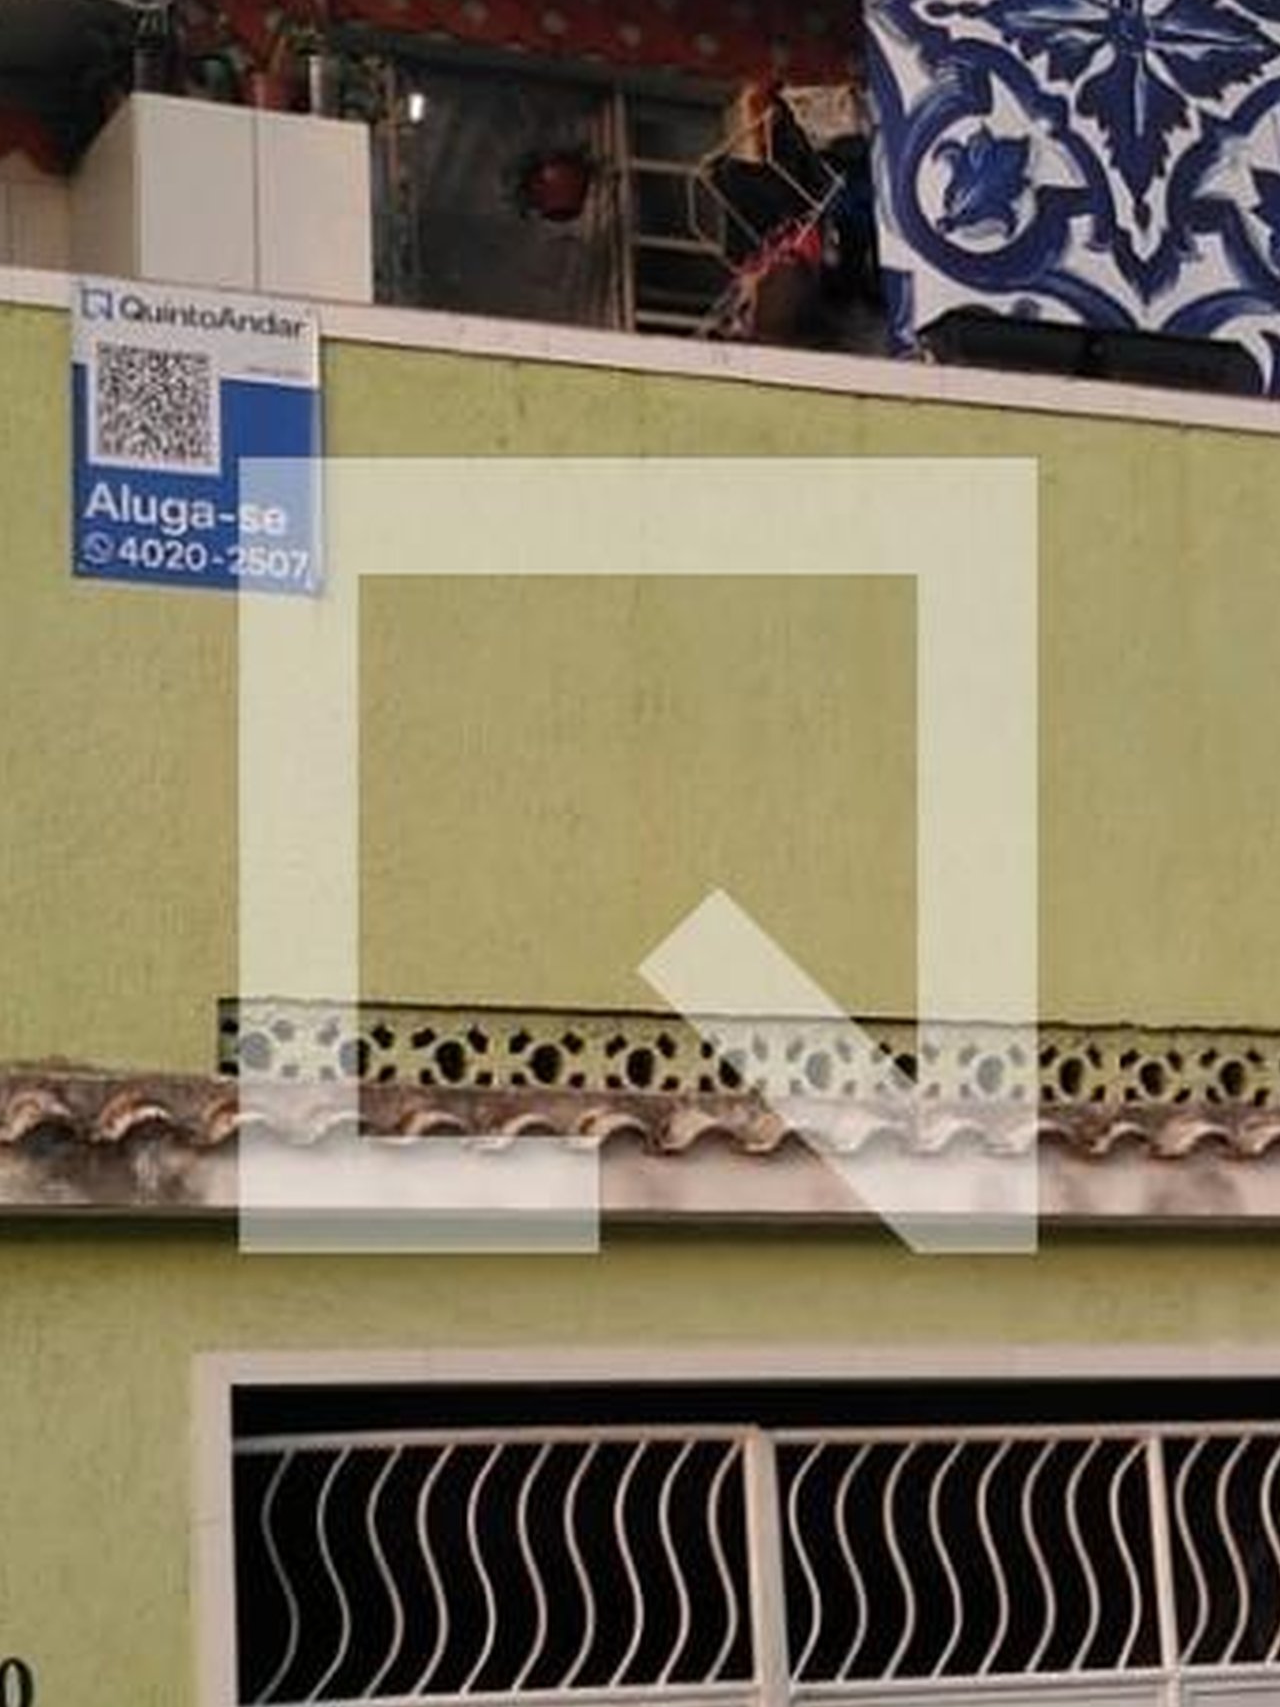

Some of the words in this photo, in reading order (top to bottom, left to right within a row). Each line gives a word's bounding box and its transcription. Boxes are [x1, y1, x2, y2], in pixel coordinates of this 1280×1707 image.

[120, 295, 306, 339] QuintoAndar
[83, 482, 287, 536] Aluga-se
[118, 537, 309, 578] 4020-2507
